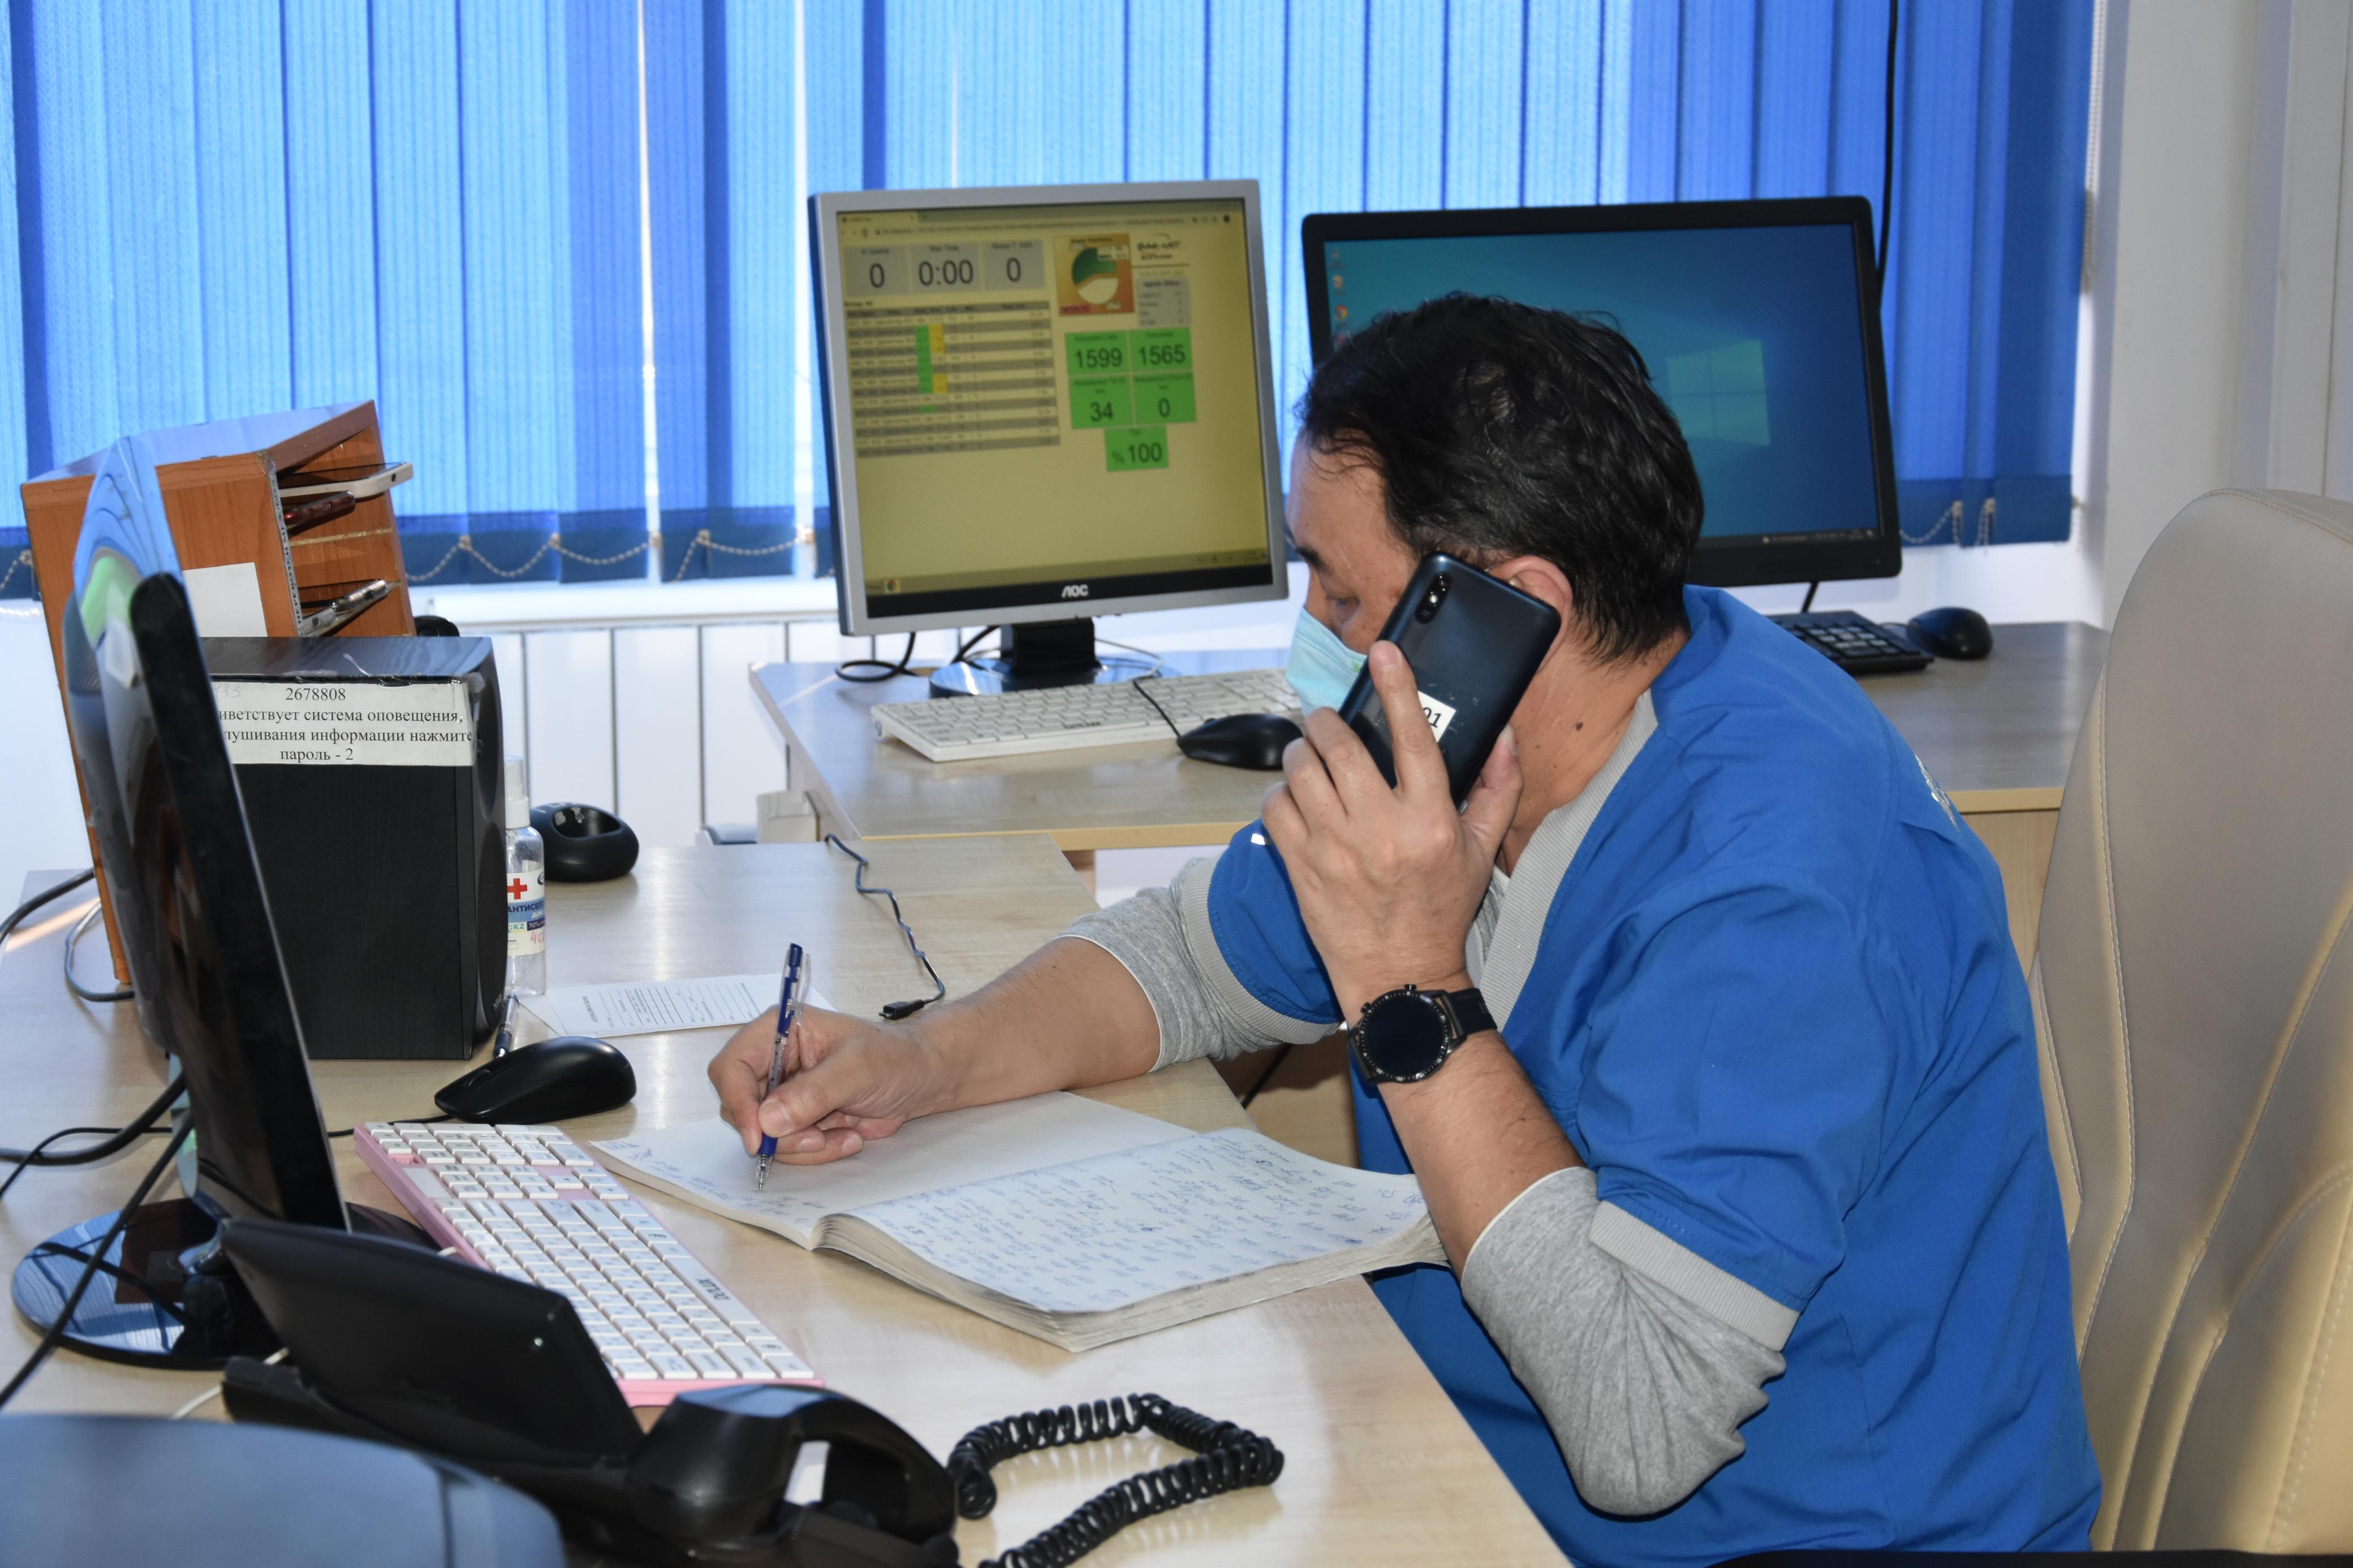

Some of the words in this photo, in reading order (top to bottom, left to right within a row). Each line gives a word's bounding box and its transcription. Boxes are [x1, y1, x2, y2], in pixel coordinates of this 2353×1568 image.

[869, 262, 885, 288] 0
[919, 259, 973, 286] 0:00
[1006, 257, 1022, 282] 0
[1076, 347, 1123, 369] 1599
[1139, 343, 1186, 365] 1565
[1089, 401, 1114, 422] 34
[1158, 397, 1171, 418] 0
[1062, 584, 1089, 599] AOC
[285, 688, 346, 701] 2678808
[218, 710, 300, 724] иветствует
[304, 711, 363, 722] система
[367, 711, 463, 724] оповещения,
[224, 731, 306, 743] лушивания
[310, 728, 405, 745] информации
[410, 732, 472, 742] нажмите
[280, 750, 331, 763] пароль
[345, 748, 354, 760] 2
[507, 901, 544, 913] АНТИСЕП
